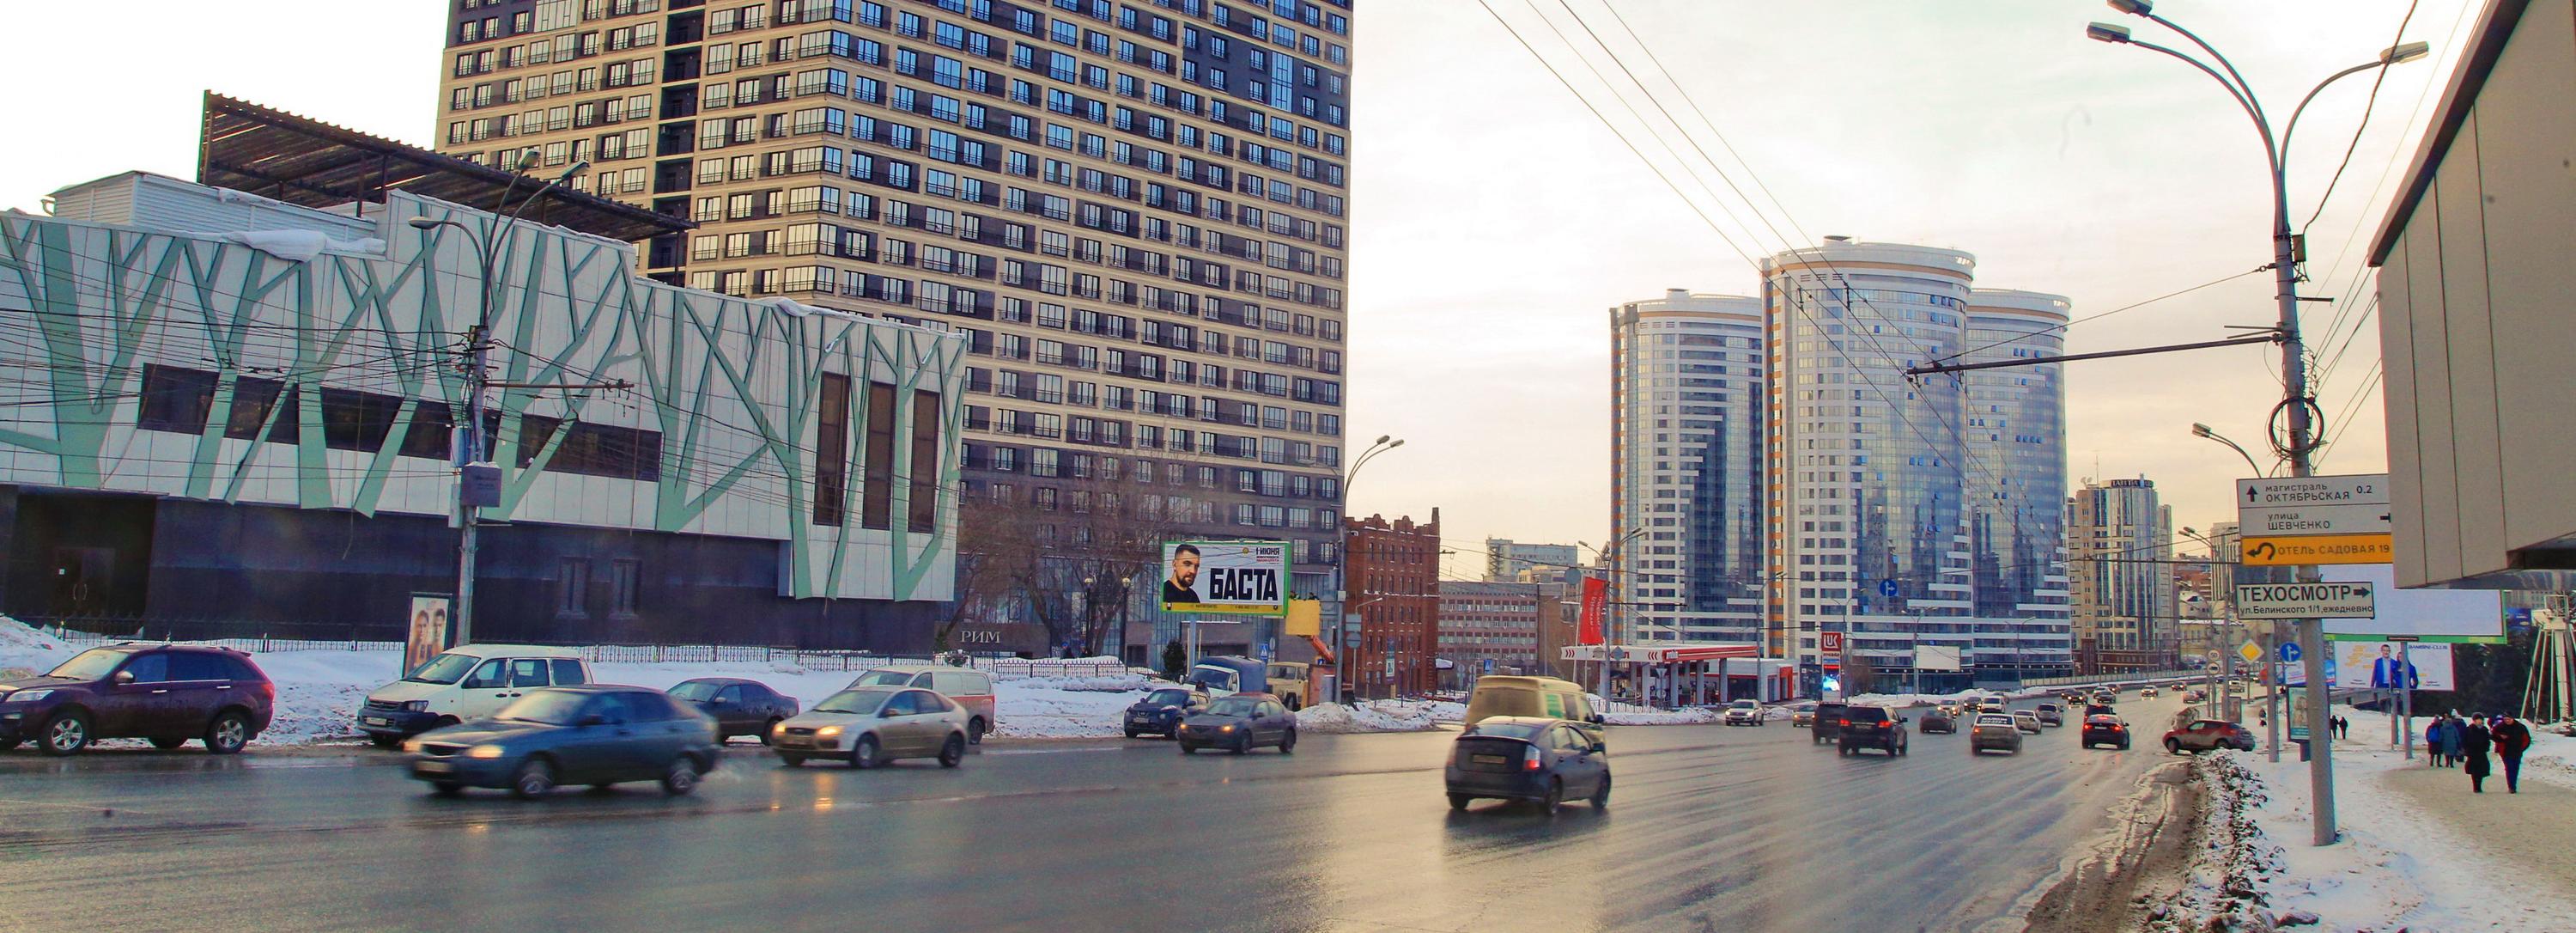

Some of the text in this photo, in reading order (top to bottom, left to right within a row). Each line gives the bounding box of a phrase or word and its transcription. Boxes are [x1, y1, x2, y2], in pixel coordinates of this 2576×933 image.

[2265, 484, 2328, 492] магистраль
[2356, 485, 2372, 494] 0.2
[2265, 491, 2350, 503] ОКТЯБРЬСКАЯ
[2267, 513, 2300, 521] улица
[2268, 520, 2330, 530] ШЕВЧЕНКО
[2278, 544, 2390, 555] ОТЕЛЬ САДОВАЯ 19
[1209, 567, 1279, 601] БАСТА
[2239, 585, 2351, 602] ТЕХОСМОТР
[2239, 605, 2306, 616] ул.Белинского
[960, 630, 1001, 643] РИМ
